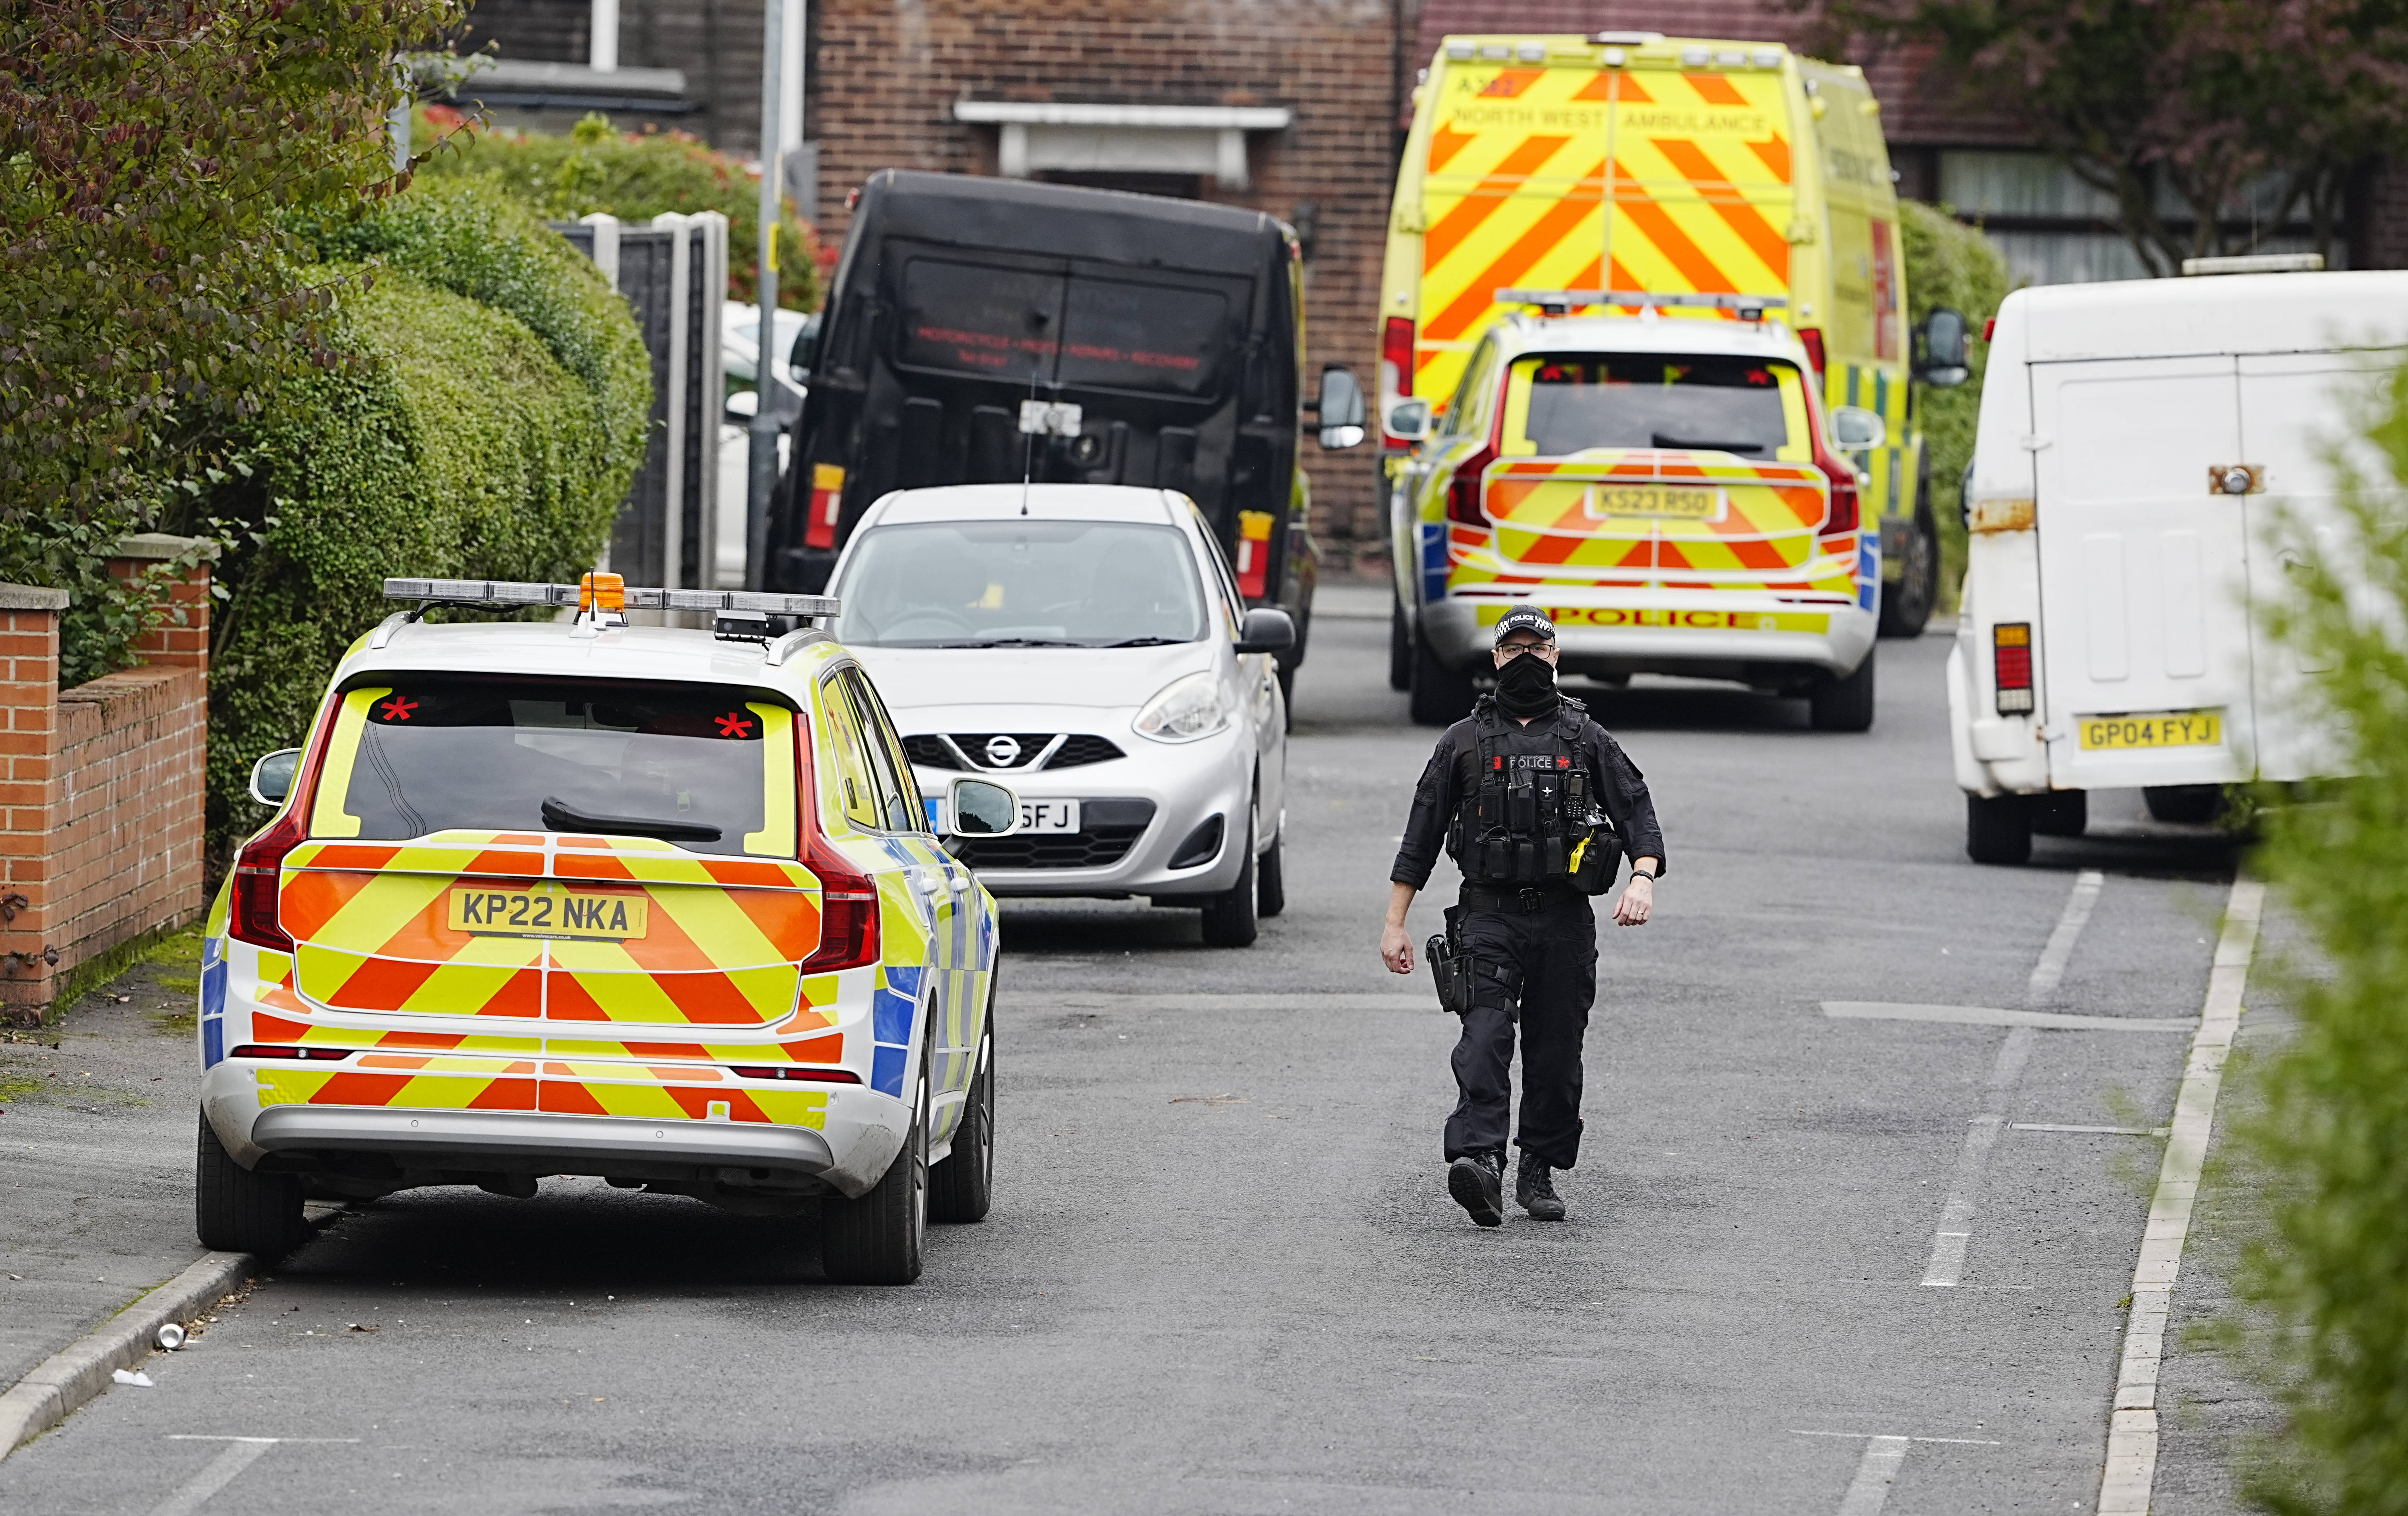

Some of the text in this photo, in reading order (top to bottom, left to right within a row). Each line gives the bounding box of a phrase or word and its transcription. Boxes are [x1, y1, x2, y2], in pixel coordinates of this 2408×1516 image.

[1453, 105, 1602, 128] NORTH WEST
[1625, 110, 1765, 132] AMBULANCE
[1599, 486, 1658, 509] KS23
[1510, 614, 1534, 623] POLICE
[1550, 608, 1757, 629] POLICE
[2090, 717, 2211, 745] GP04 FYJ
[1510, 759, 1551, 768] POLICE
[464, 893, 552, 926] KP22
[563, 898, 628, 931] NKA
